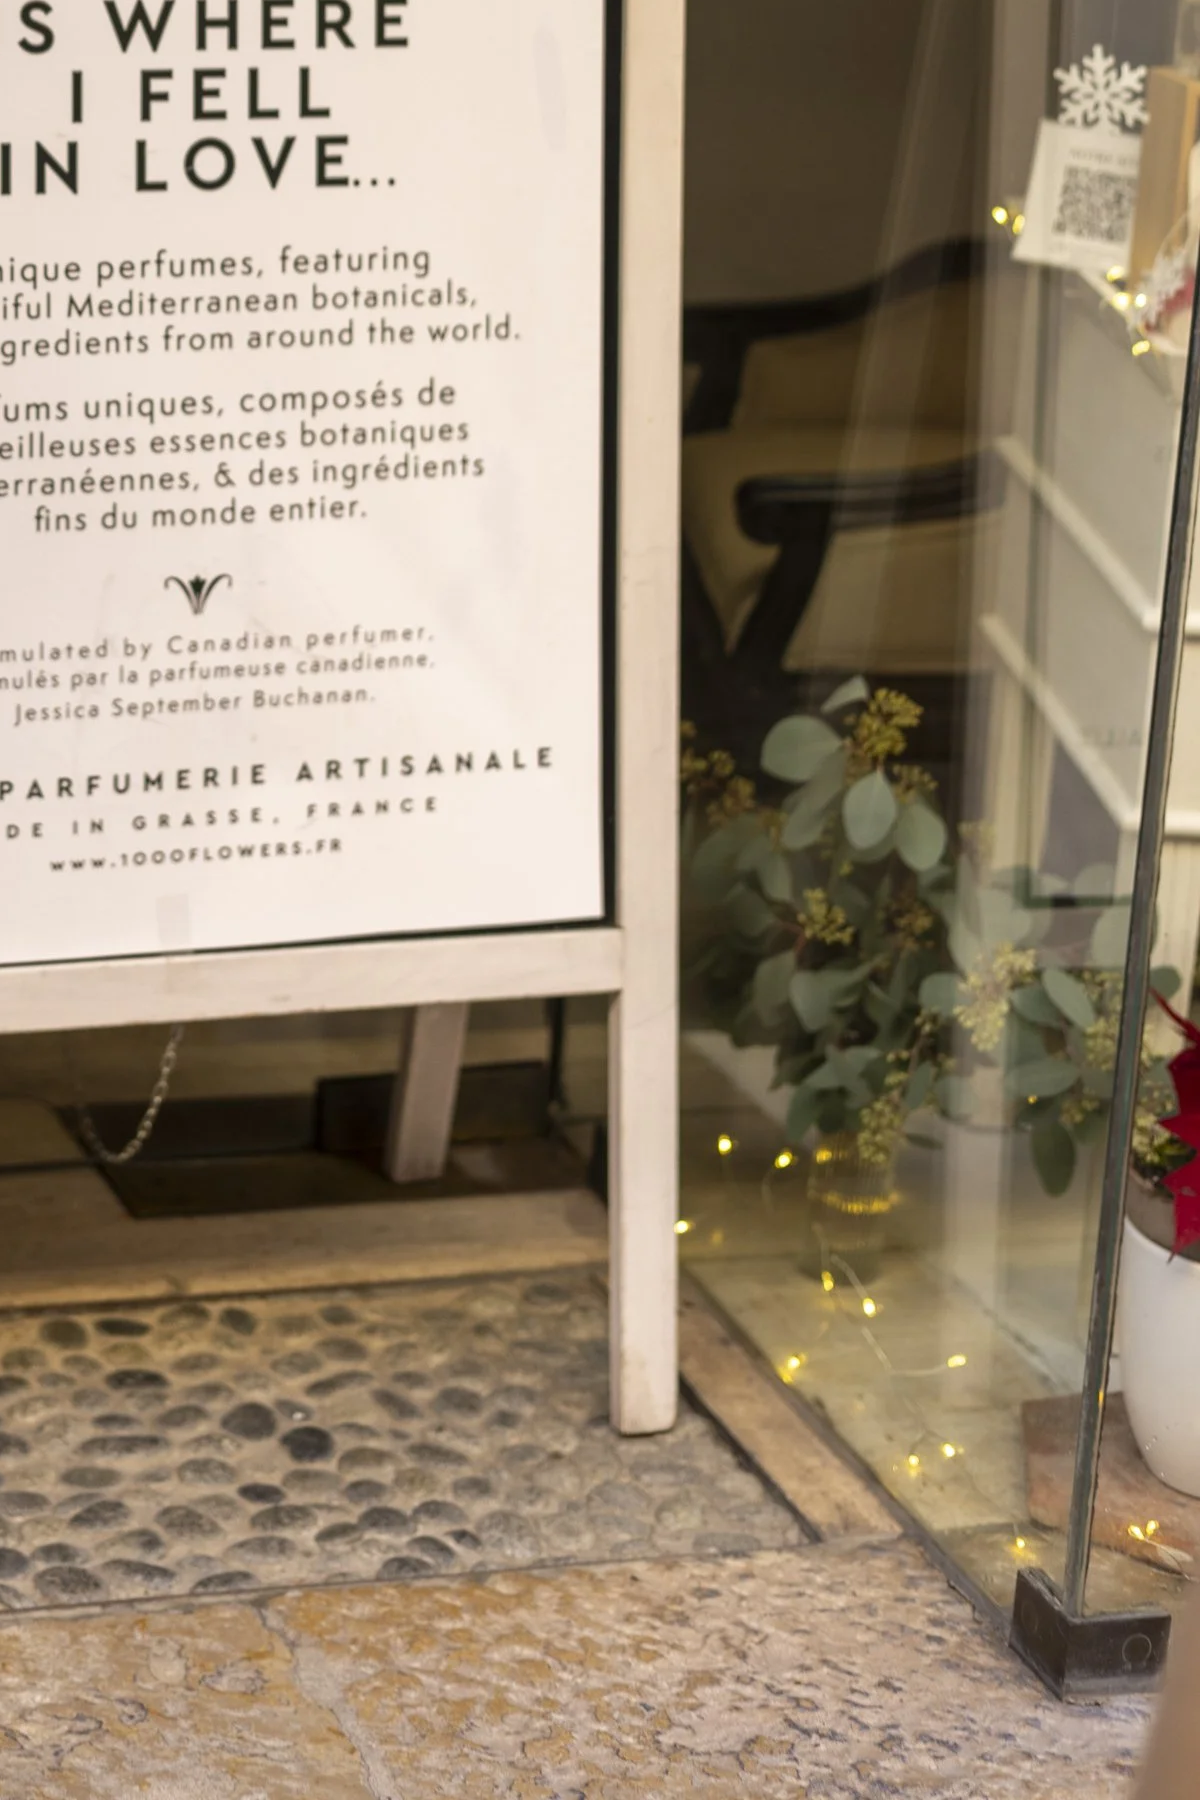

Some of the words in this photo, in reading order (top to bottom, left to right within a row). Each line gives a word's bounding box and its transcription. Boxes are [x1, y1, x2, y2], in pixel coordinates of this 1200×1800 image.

[71, 70, 83, 124] I
[140, 66, 331, 123] FELL
[0, 141, 79, 196] IN
[135, 134, 395, 193] LOVE...
[96, 248, 263, 289] perfumes,
[279, 244, 430, 279] featuring
[66, 289, 298, 318] Mediterranean
[311, 278, 476, 311] botanicals,
[162, 324, 234, 352] from
[246, 318, 354, 350] around
[367, 317, 415, 344] the
[427, 312, 520, 343] world.
[83, 391, 223, 425] uniques,
[239, 379, 404, 419] composés
[417, 376, 456, 407] de
[149, 430, 287, 455] essences
[299, 419, 469, 451] botaniques
[213, 461, 236, 489] &
[248, 458, 300, 487] des
[312, 452, 485, 491] ingrédients
[34, 504, 87, 533] fins
[100, 501, 138, 531] du
[151, 496, 256, 528] monde
[268, 495, 366, 523] entier.
[123, 637, 152, 661] by
[166, 631, 292, 656] Canadian
[70, 671, 108, 692] par
[118, 664, 139, 685] la
[149, 660, 286, 688] parfumeuse
[13, 702, 100, 728] Jessica
[111, 692, 241, 720] September
[252, 686, 376, 709] Buchanan.
[295, 746, 551, 782] ARTISANALE
[72, 819, 104, 835] IN
[131, 807, 279, 832] GRASSE,
[306, 796, 436, 818] FRANCE
[49, 837, 342, 872] www.1000FLOWERS.FR
